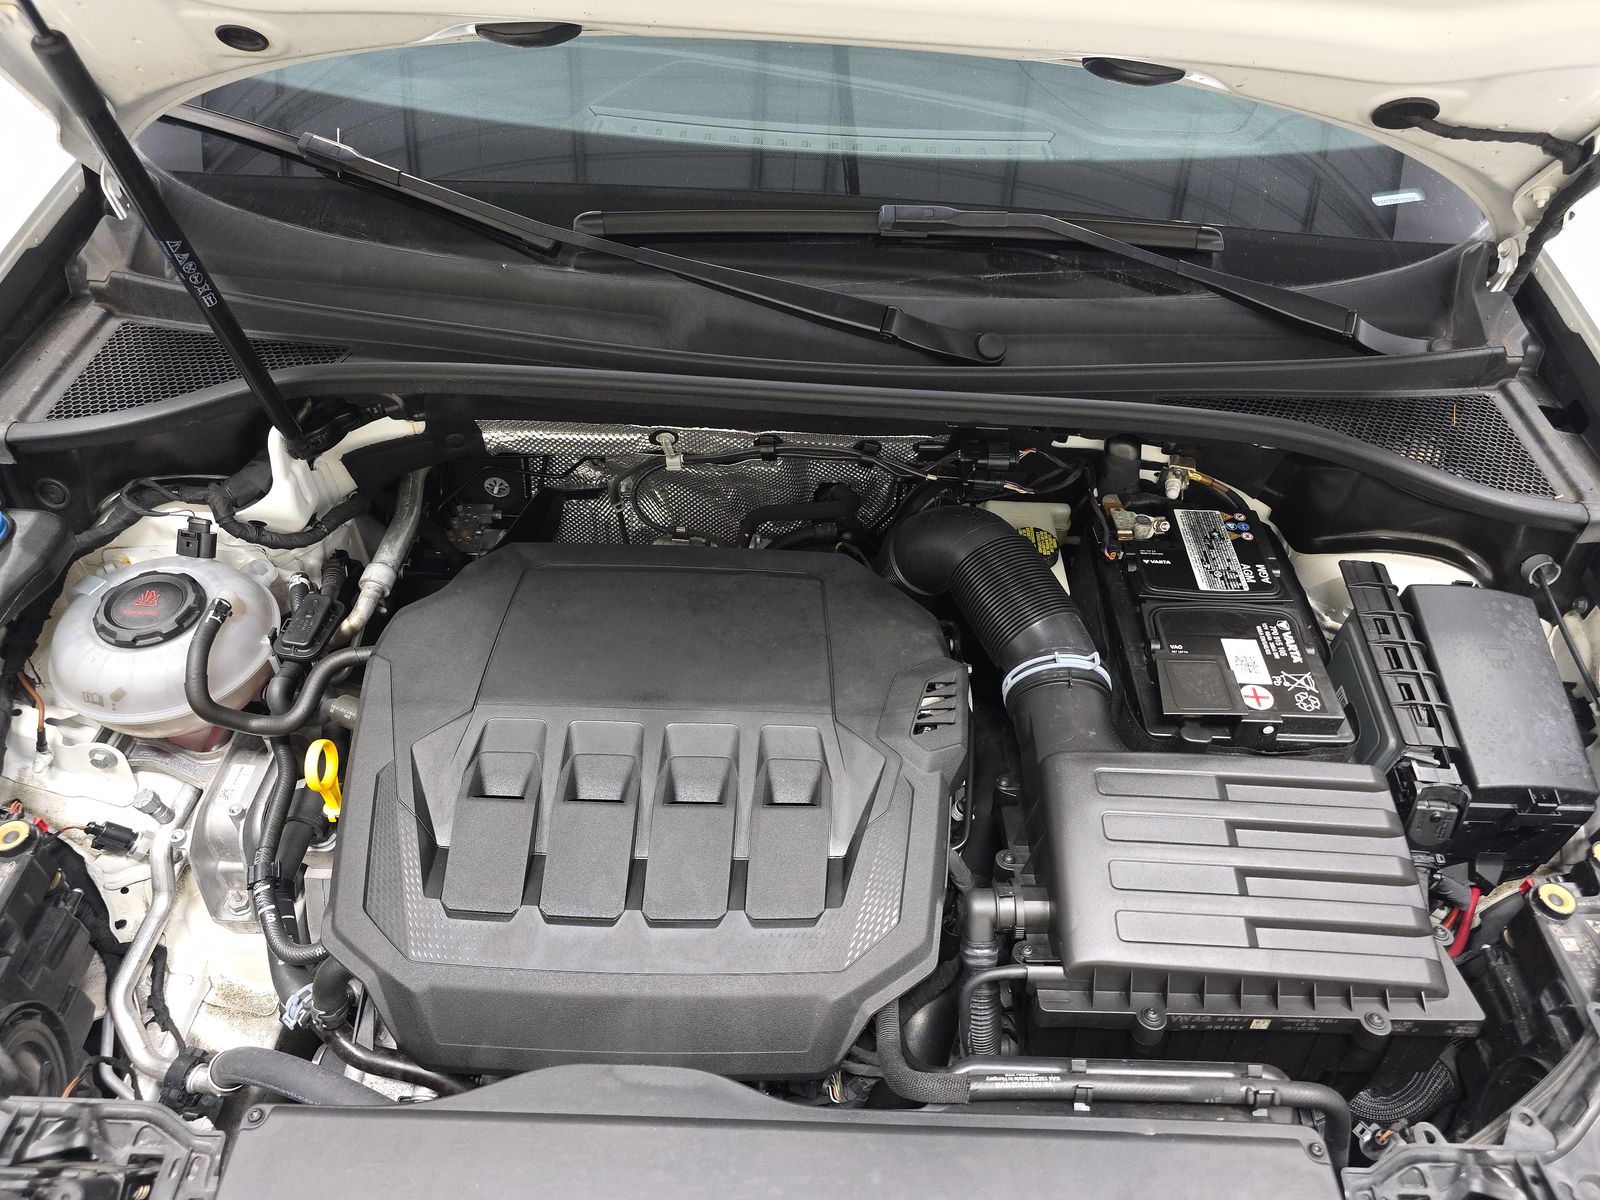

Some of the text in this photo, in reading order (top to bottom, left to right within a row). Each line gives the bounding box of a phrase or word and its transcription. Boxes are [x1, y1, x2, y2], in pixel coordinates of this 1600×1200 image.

[1240, 563, 1257, 583] AGM
[1255, 564, 1272, 584] AGM
[1282, 630, 1303, 664] VARTA
[1272, 675, 1282, 687] Pb
